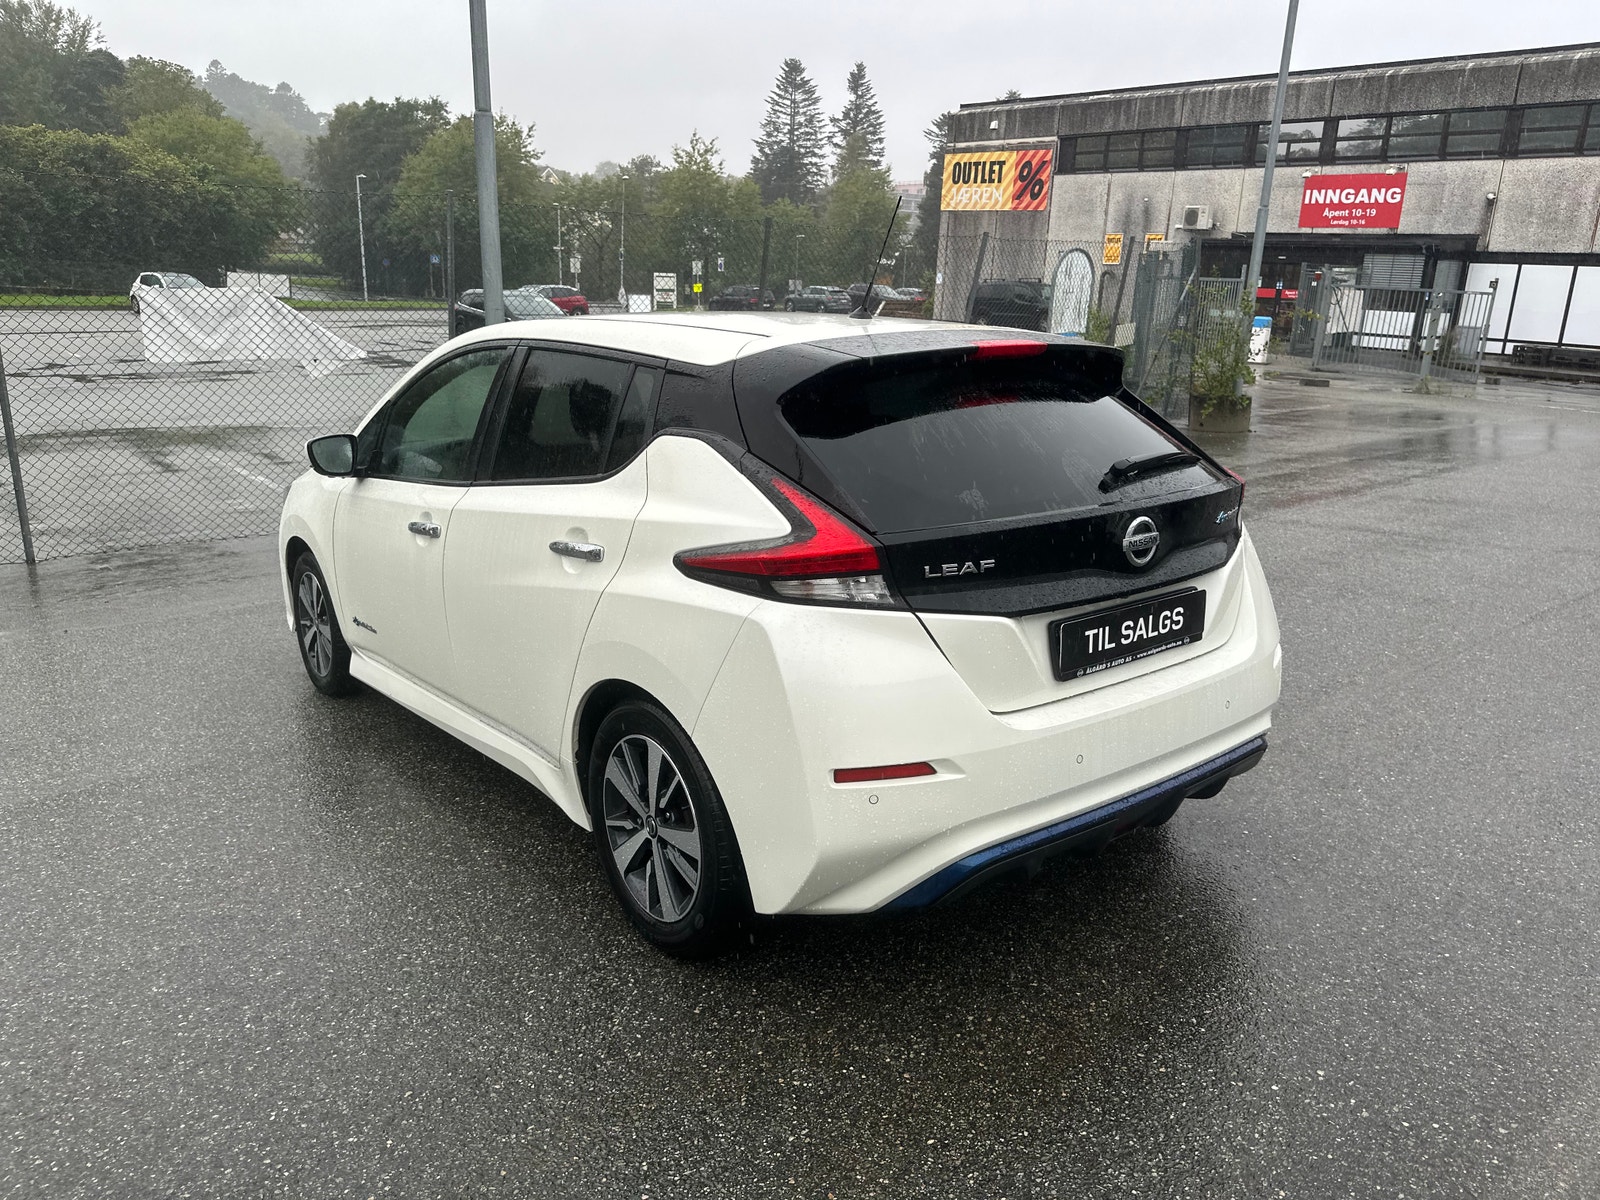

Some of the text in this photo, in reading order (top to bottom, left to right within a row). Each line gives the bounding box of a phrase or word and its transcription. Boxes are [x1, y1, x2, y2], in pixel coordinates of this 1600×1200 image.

[952, 160, 1006, 185] OUTLET
[1015, 160, 1048, 201] %
[949, 187, 1004, 206] JÆREN
[1304, 188, 1402, 204] INNGANG
[1323, 207, 1377, 218] Åpent 10-19
[1129, 535, 1157, 548] NISSAN
[924, 559, 996, 579] LEAF
[1085, 607, 1184, 654] TIL SALGS
[1111, 658, 1125, 667] AUTO
